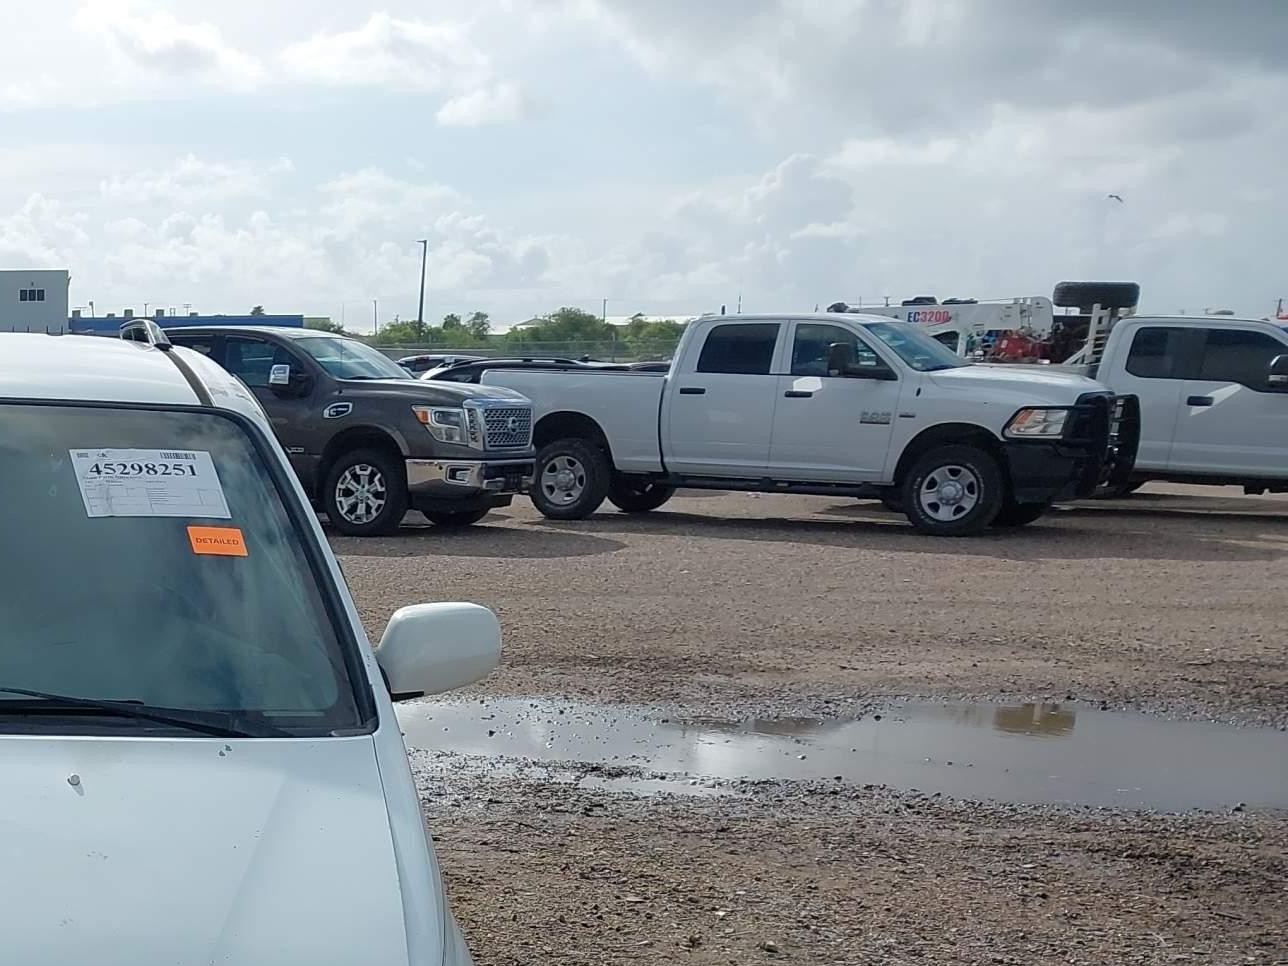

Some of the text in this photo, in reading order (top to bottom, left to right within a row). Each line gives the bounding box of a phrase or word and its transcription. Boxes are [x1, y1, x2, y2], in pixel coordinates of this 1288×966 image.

[907, 311, 950, 323] EC3200
[89, 463, 198, 477] 45298251
[195, 537, 240, 546] DETAILED
